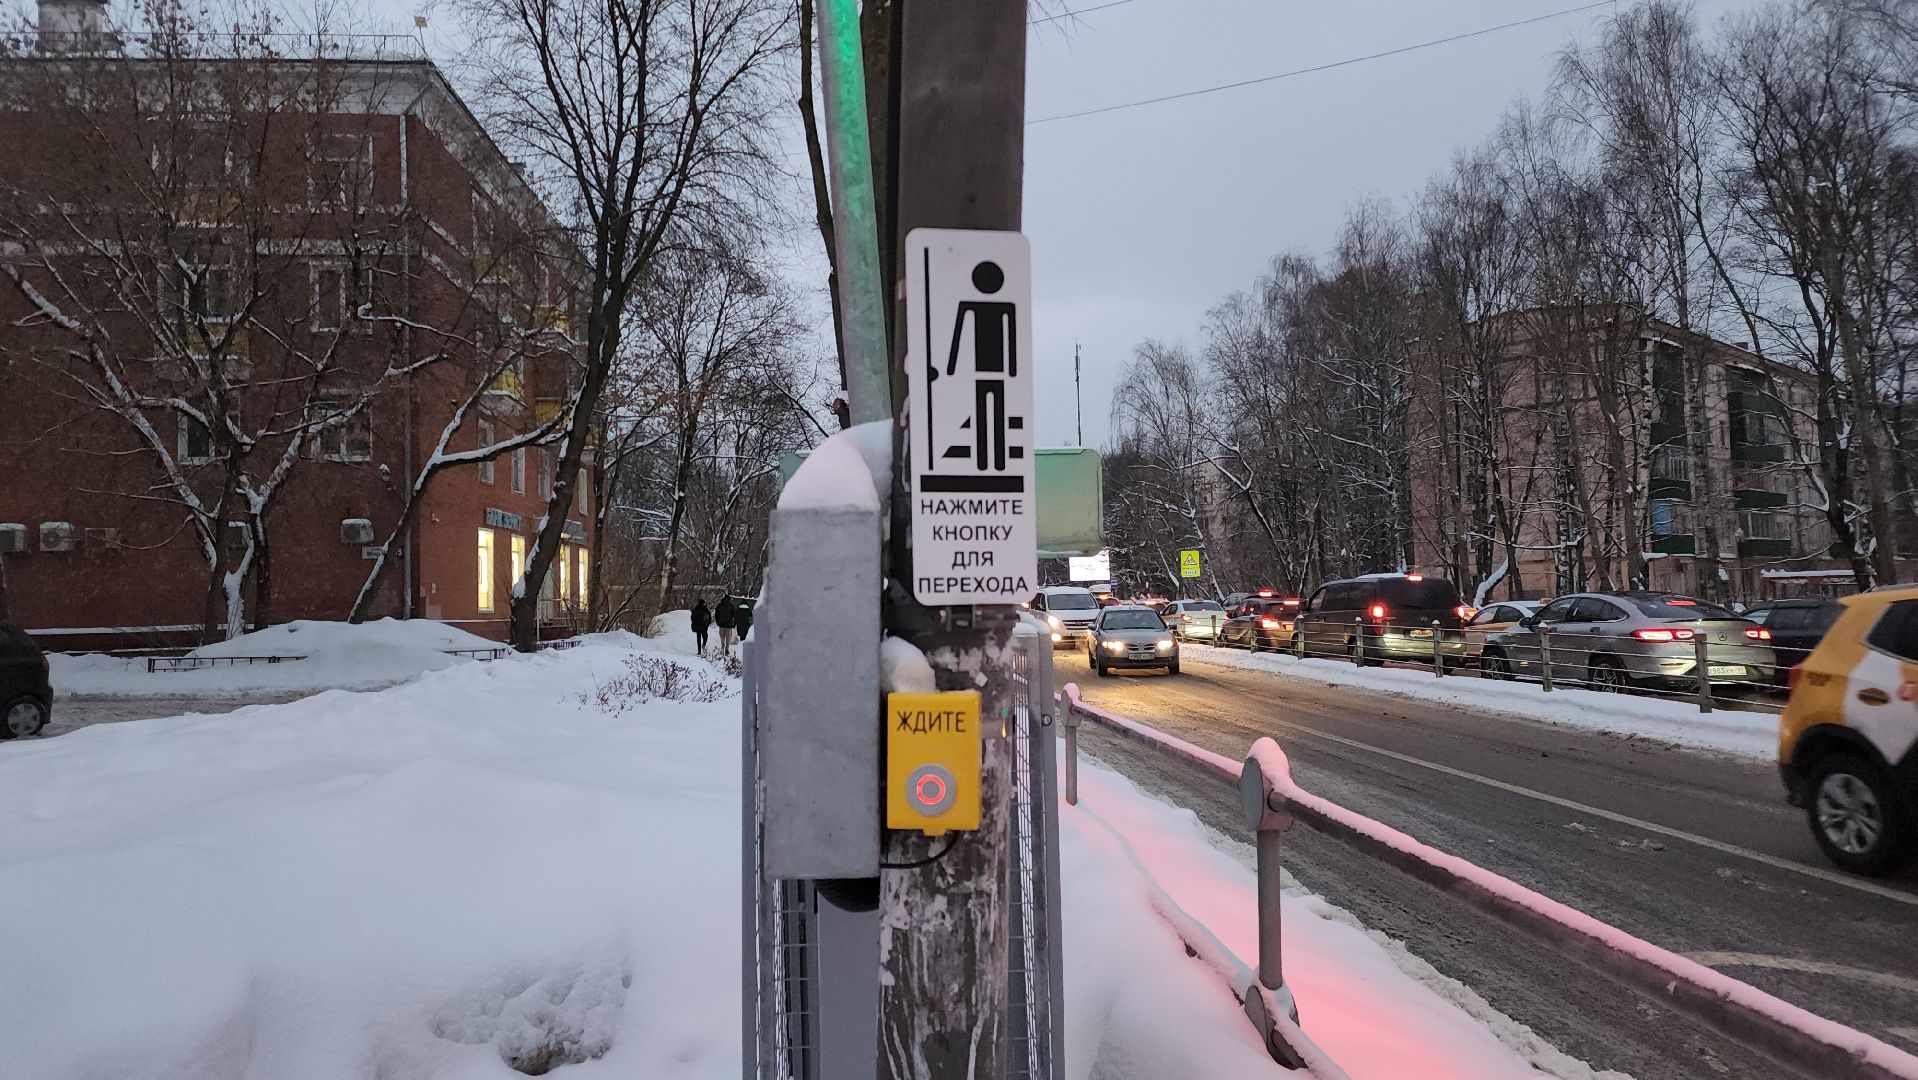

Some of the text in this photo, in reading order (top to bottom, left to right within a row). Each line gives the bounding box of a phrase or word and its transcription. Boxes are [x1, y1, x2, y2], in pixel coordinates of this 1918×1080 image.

[921, 498, 1023, 516] НАЖМИТЕ
[932, 525, 1013, 541] КНОПКУ
[951, 551, 994, 570] ДЛЯ
[918, 576, 1029, 595] ПЕРЕХОДА
[897, 711, 967, 735] ЖДИТЕ
